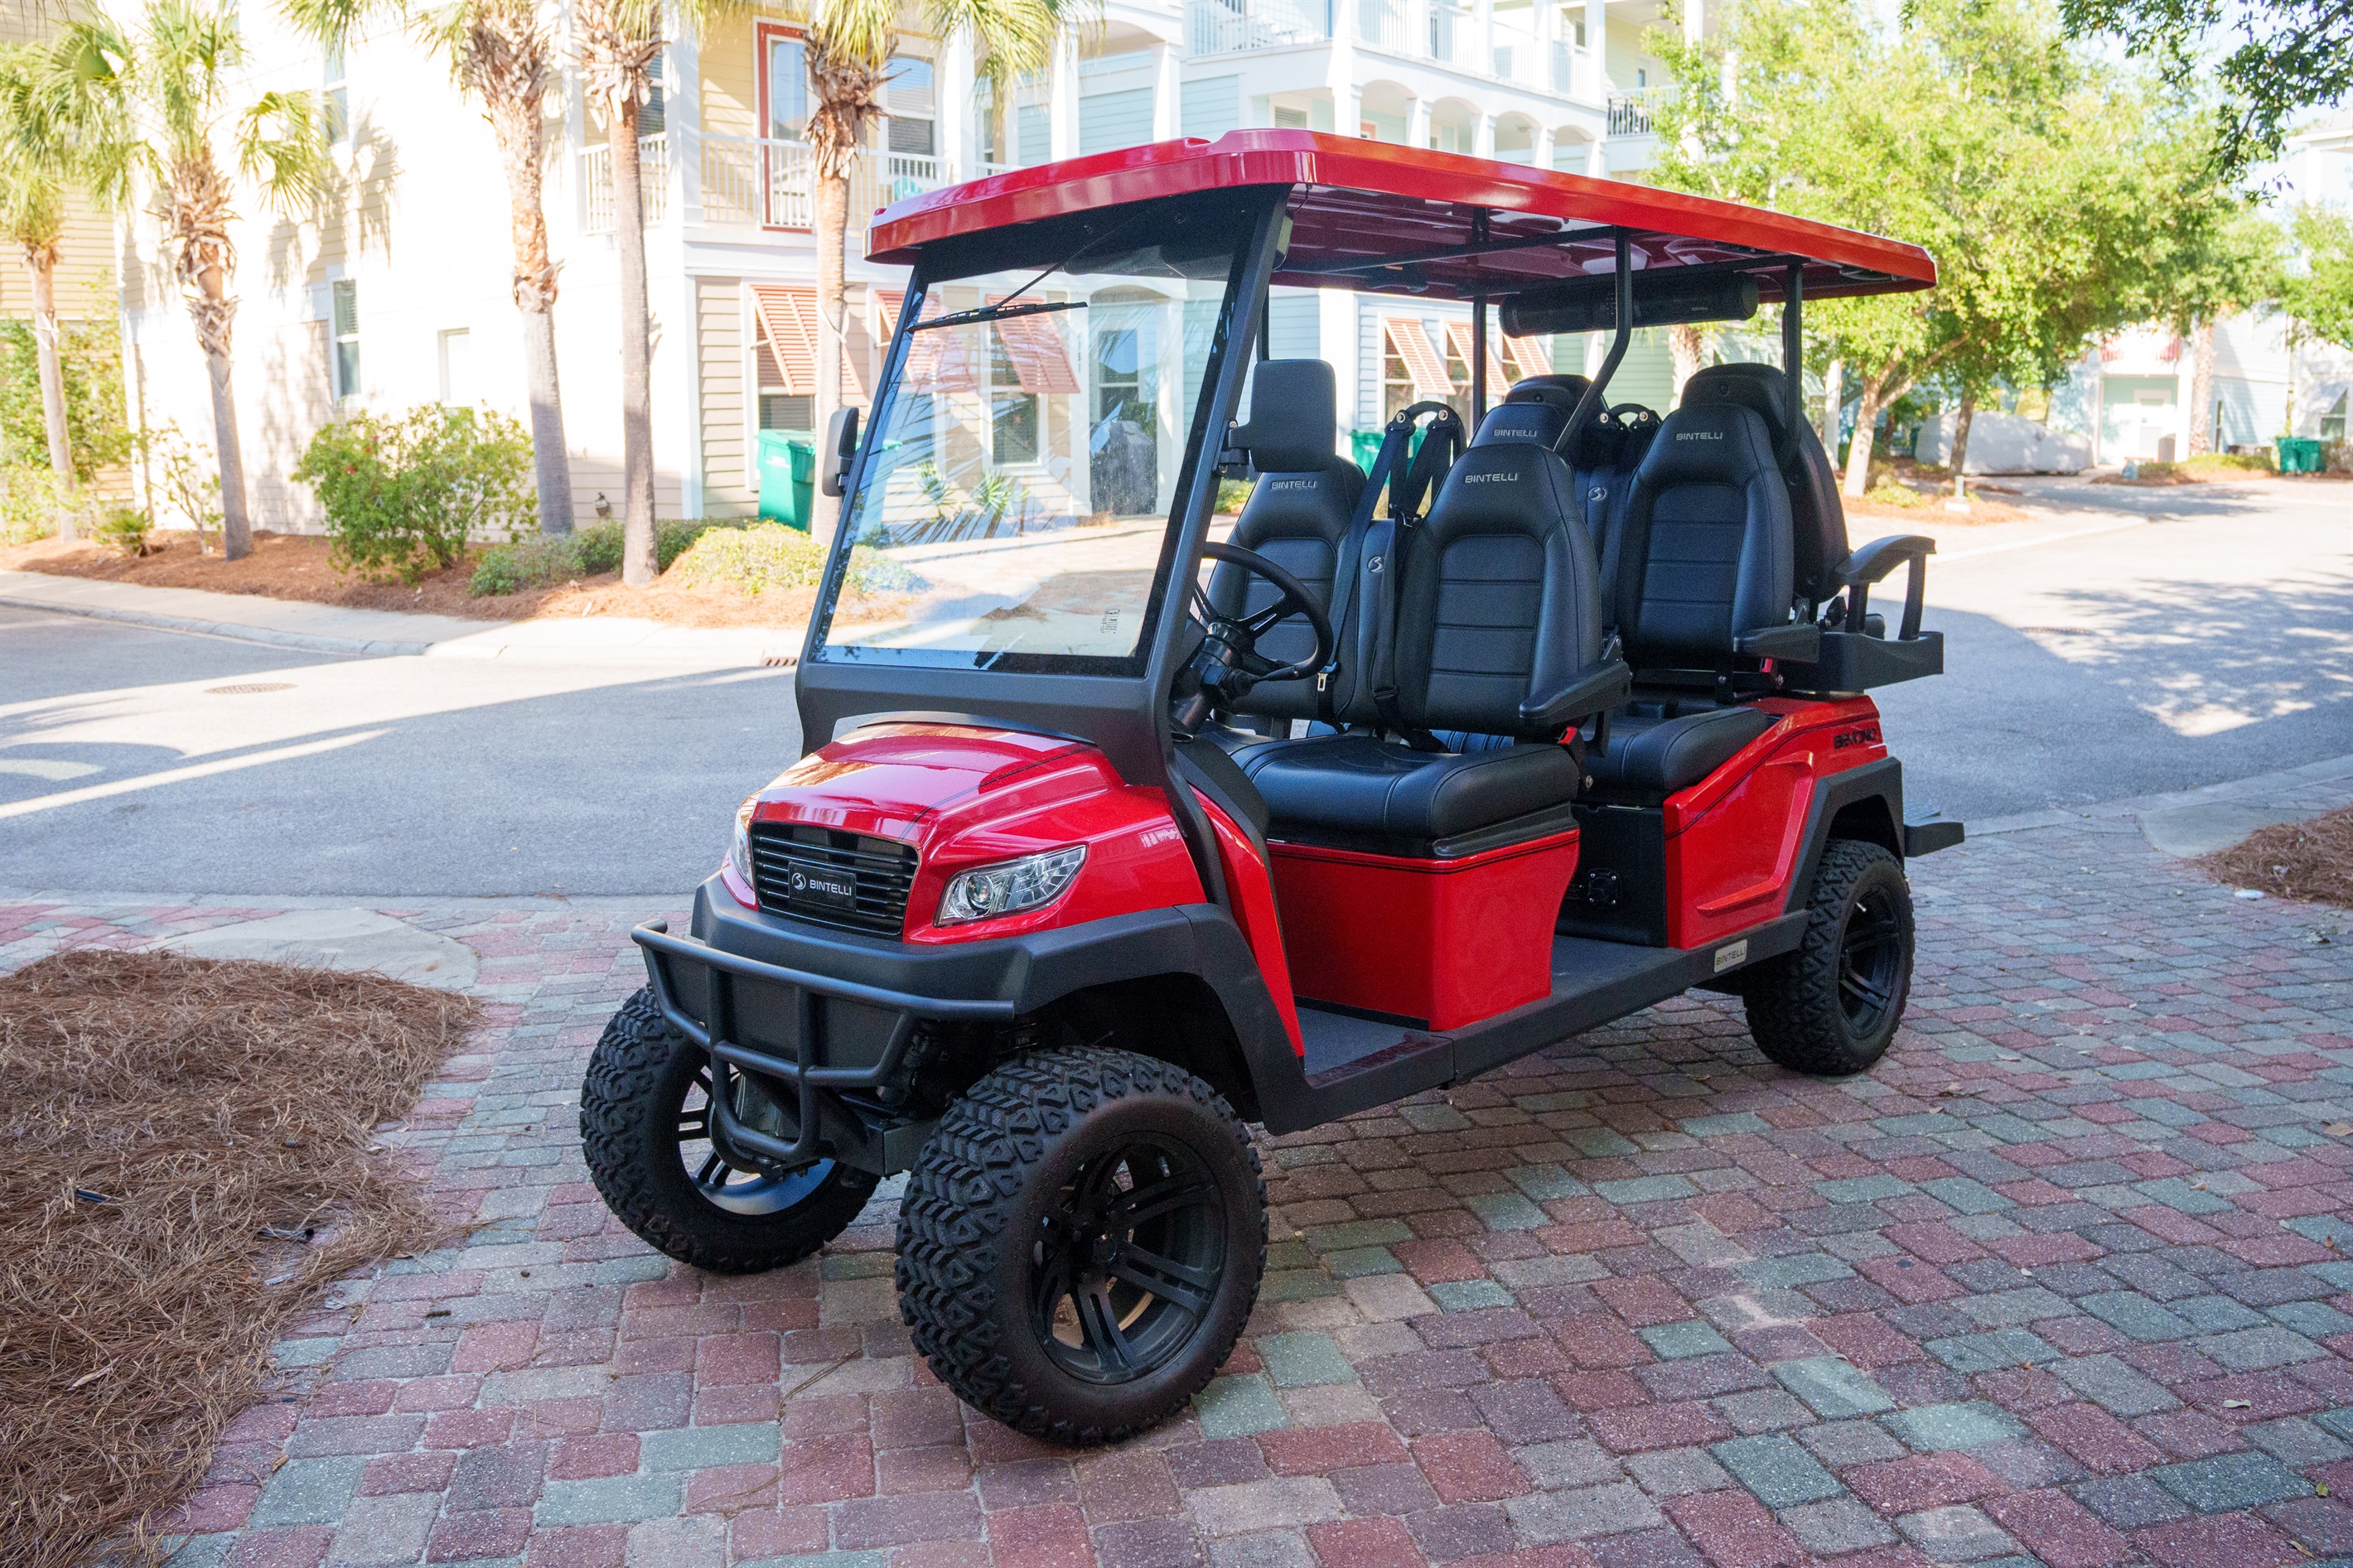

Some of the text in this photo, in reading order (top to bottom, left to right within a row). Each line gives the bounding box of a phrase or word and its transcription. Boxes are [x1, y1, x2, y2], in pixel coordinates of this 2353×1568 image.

[1493, 428, 1537, 438] BINTELLI
[1675, 432, 1723, 441] BINTELLI
[1464, 472, 1518, 484] BINTELLI
[1270, 480, 1317, 490] BINTELLI
[809, 879, 852, 896] BINTELLI
[1716, 946, 1747, 966] BINTELLI
